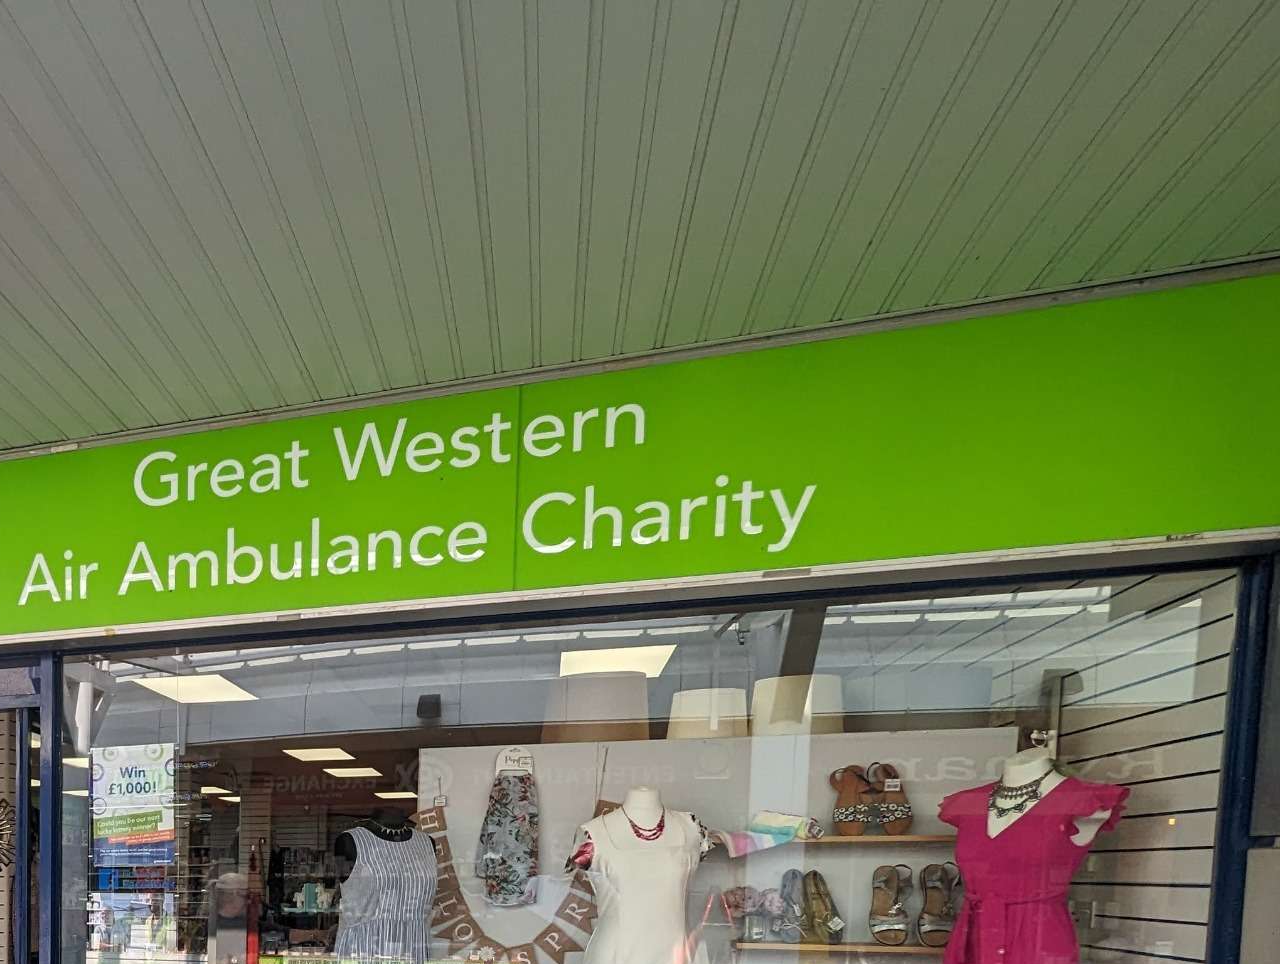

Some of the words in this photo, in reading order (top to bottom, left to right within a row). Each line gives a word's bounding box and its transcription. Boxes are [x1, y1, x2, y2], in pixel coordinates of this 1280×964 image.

[133, 439, 309, 509] Great
[332, 402, 646, 481] Western
[17, 548, 99, 606] Air
[118, 518, 488, 597] Ambulance
[521, 474, 818, 553] Charity
[108, 781, 157, 796] £1,000!
[120, 766, 146, 779] Win
